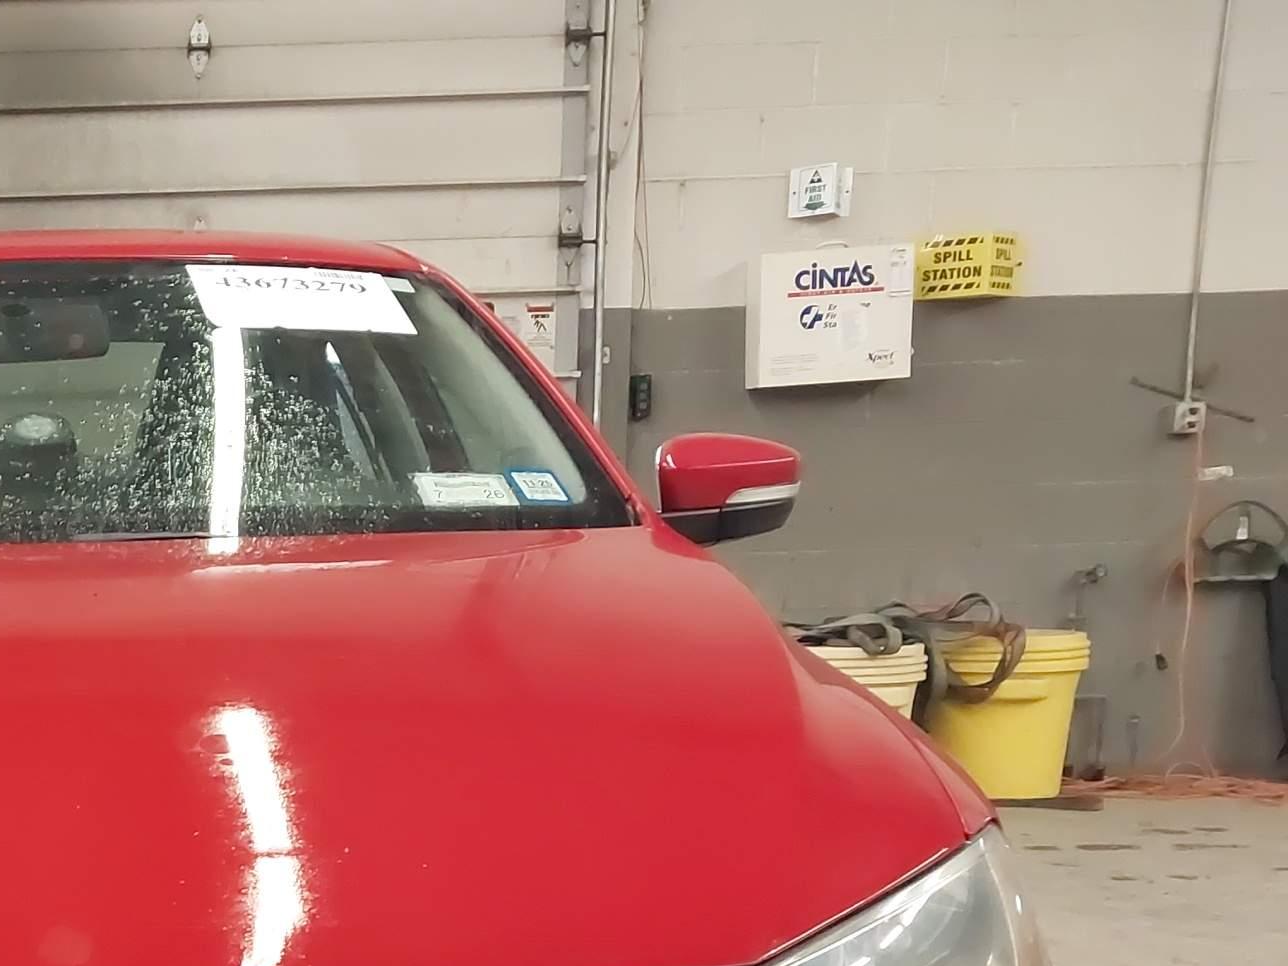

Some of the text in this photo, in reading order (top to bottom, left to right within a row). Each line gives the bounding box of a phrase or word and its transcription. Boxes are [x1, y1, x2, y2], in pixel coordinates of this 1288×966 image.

[804, 184, 827, 195] FIRST
[933, 249, 974, 265] SPILL
[921, 265, 983, 282] STATION
